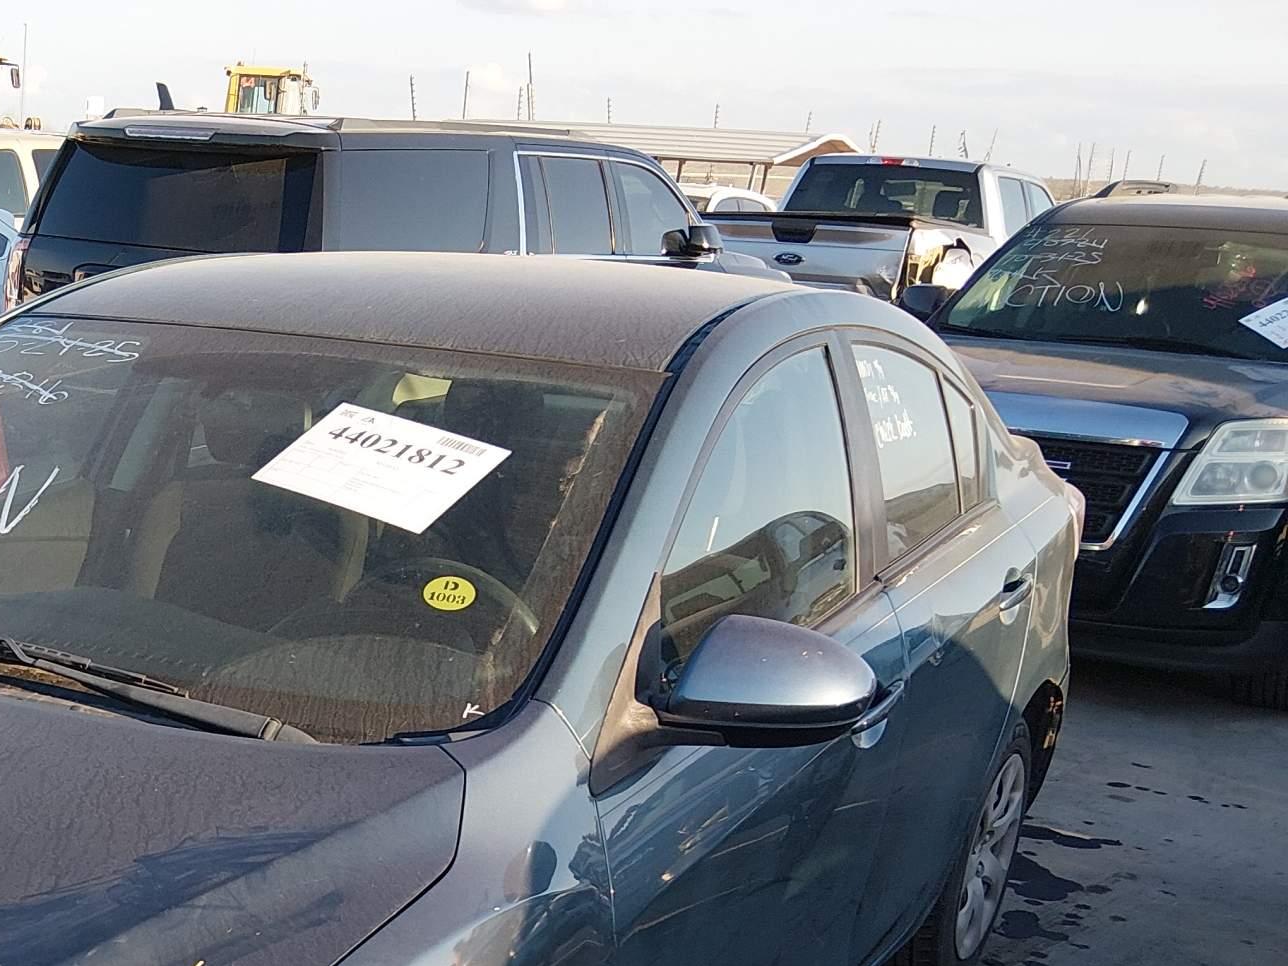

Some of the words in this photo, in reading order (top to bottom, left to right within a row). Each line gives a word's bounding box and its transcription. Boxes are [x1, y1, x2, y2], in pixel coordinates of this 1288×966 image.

[328, 426, 465, 475] 44021812
[443, 580, 460, 591] D
[428, 591, 467, 605] 1003
